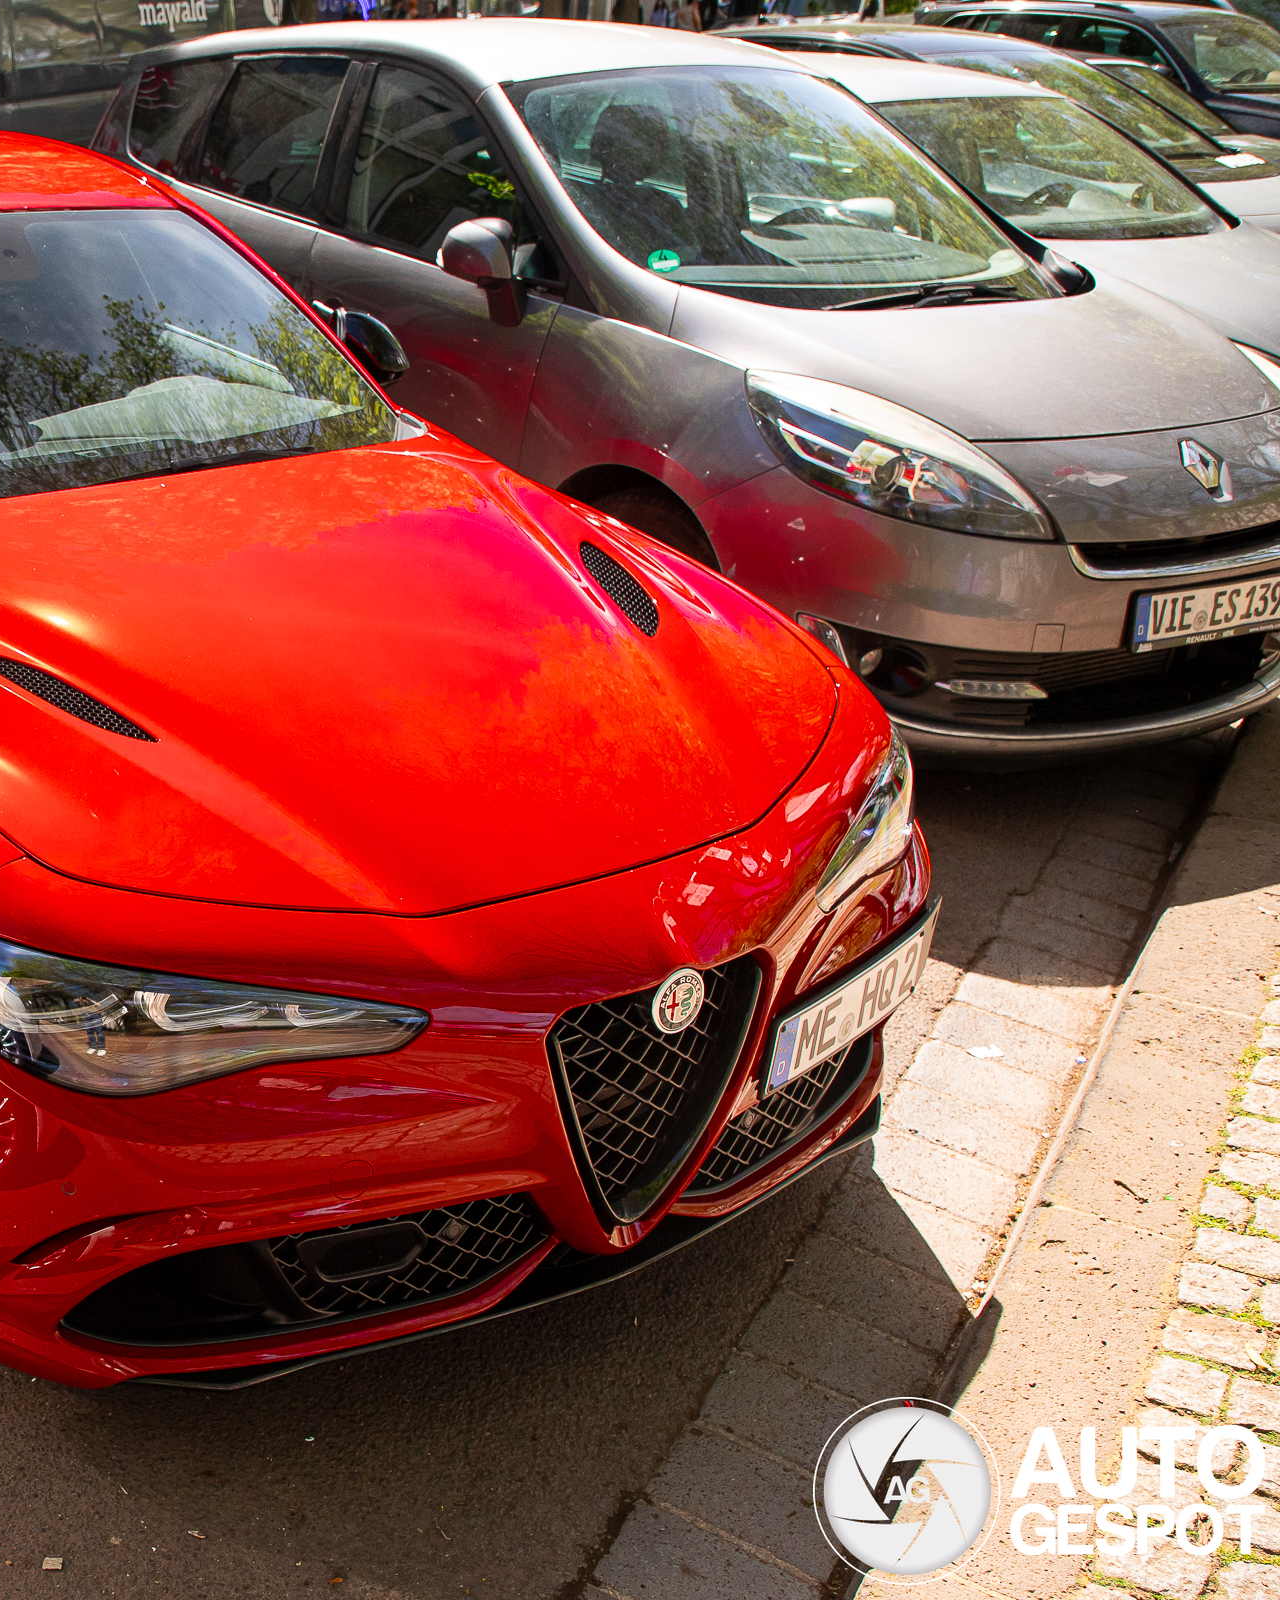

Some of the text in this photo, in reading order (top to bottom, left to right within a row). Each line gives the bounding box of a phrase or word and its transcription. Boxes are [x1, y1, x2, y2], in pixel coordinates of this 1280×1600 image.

[1152, 595, 1196, 635] VIE
[1137, 624, 1144, 636] D
[1186, 632, 1218, 645] RENAULT
[660, 976, 702, 1009] ALFA ROMEO
[794, 942, 919, 1070] ME HQ 2
[777, 1060, 787, 1077] D
